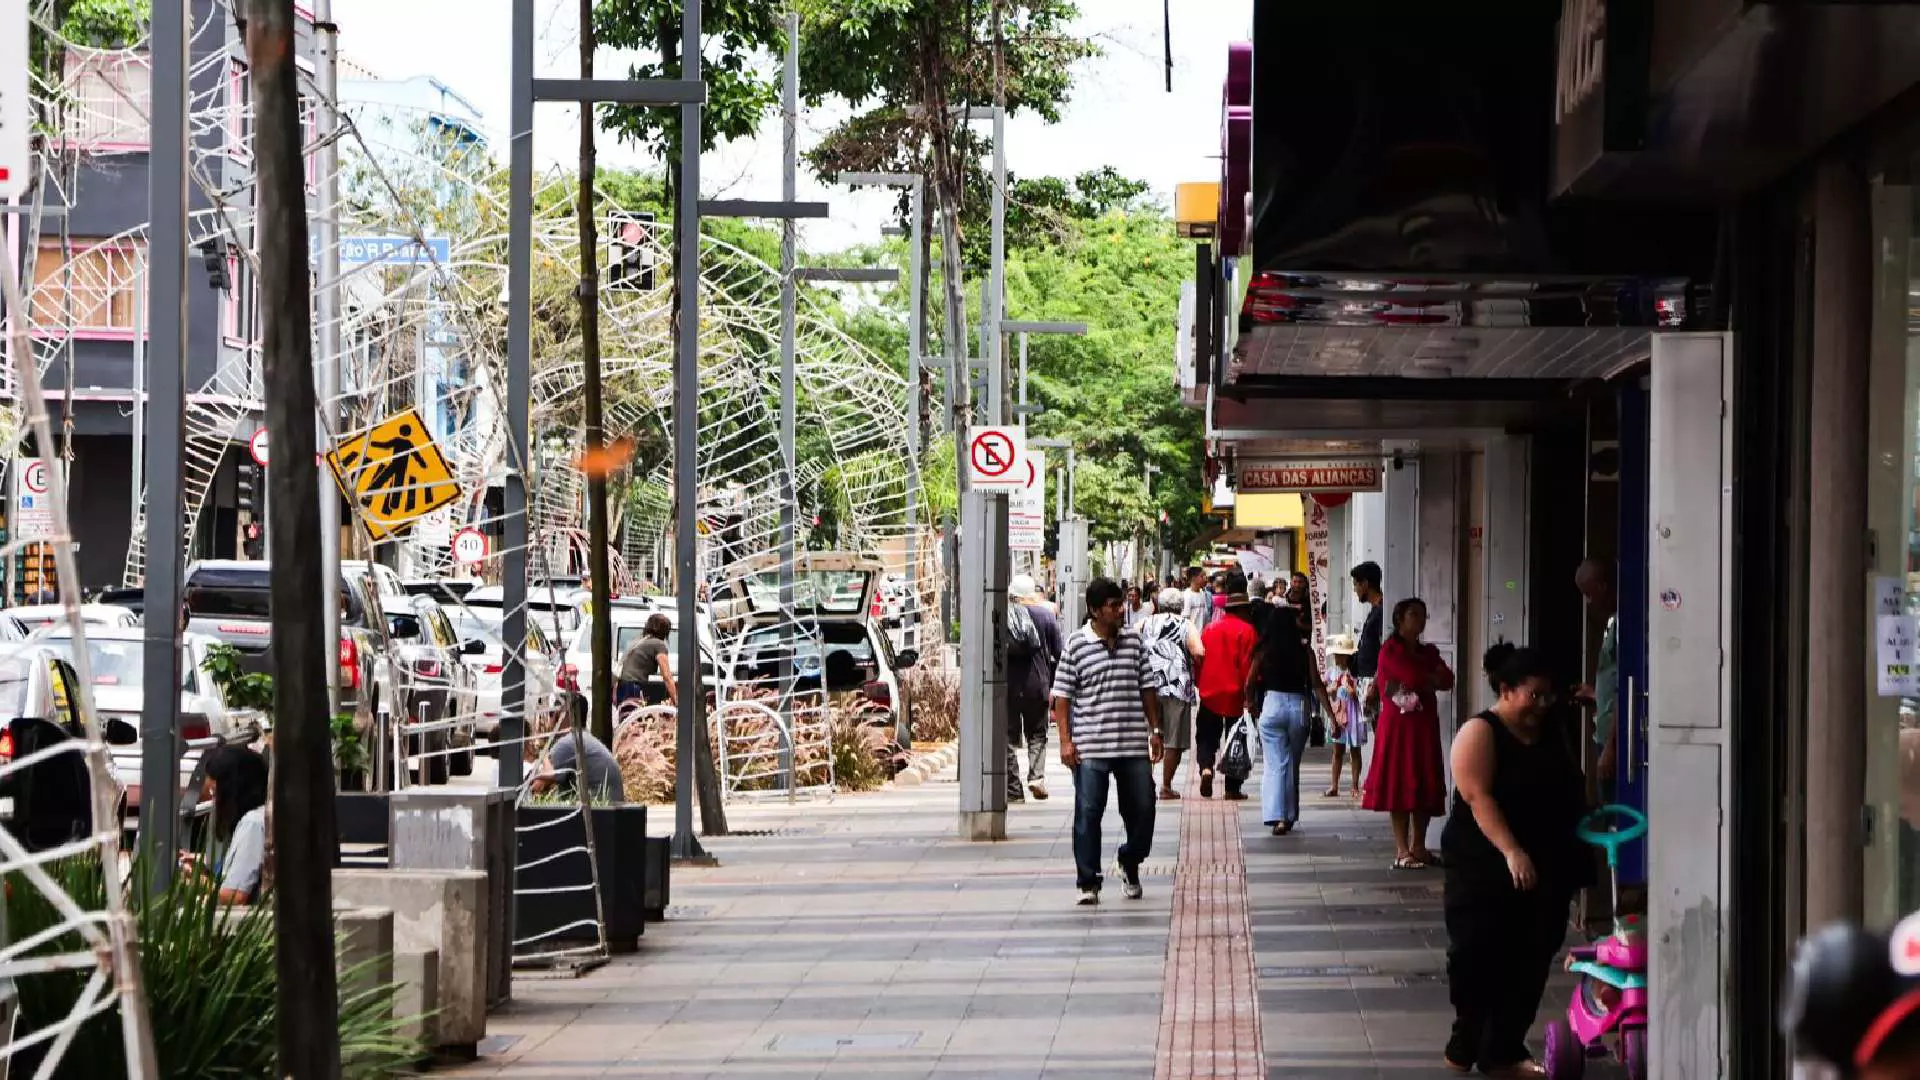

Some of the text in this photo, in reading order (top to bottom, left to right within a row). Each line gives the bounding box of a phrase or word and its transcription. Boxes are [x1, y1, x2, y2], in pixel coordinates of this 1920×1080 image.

[985, 442, 1000, 466] E
[1244, 472, 1278, 486] CASA
[1282, 471, 1308, 485] DAS
[459, 539, 478, 551] 40
